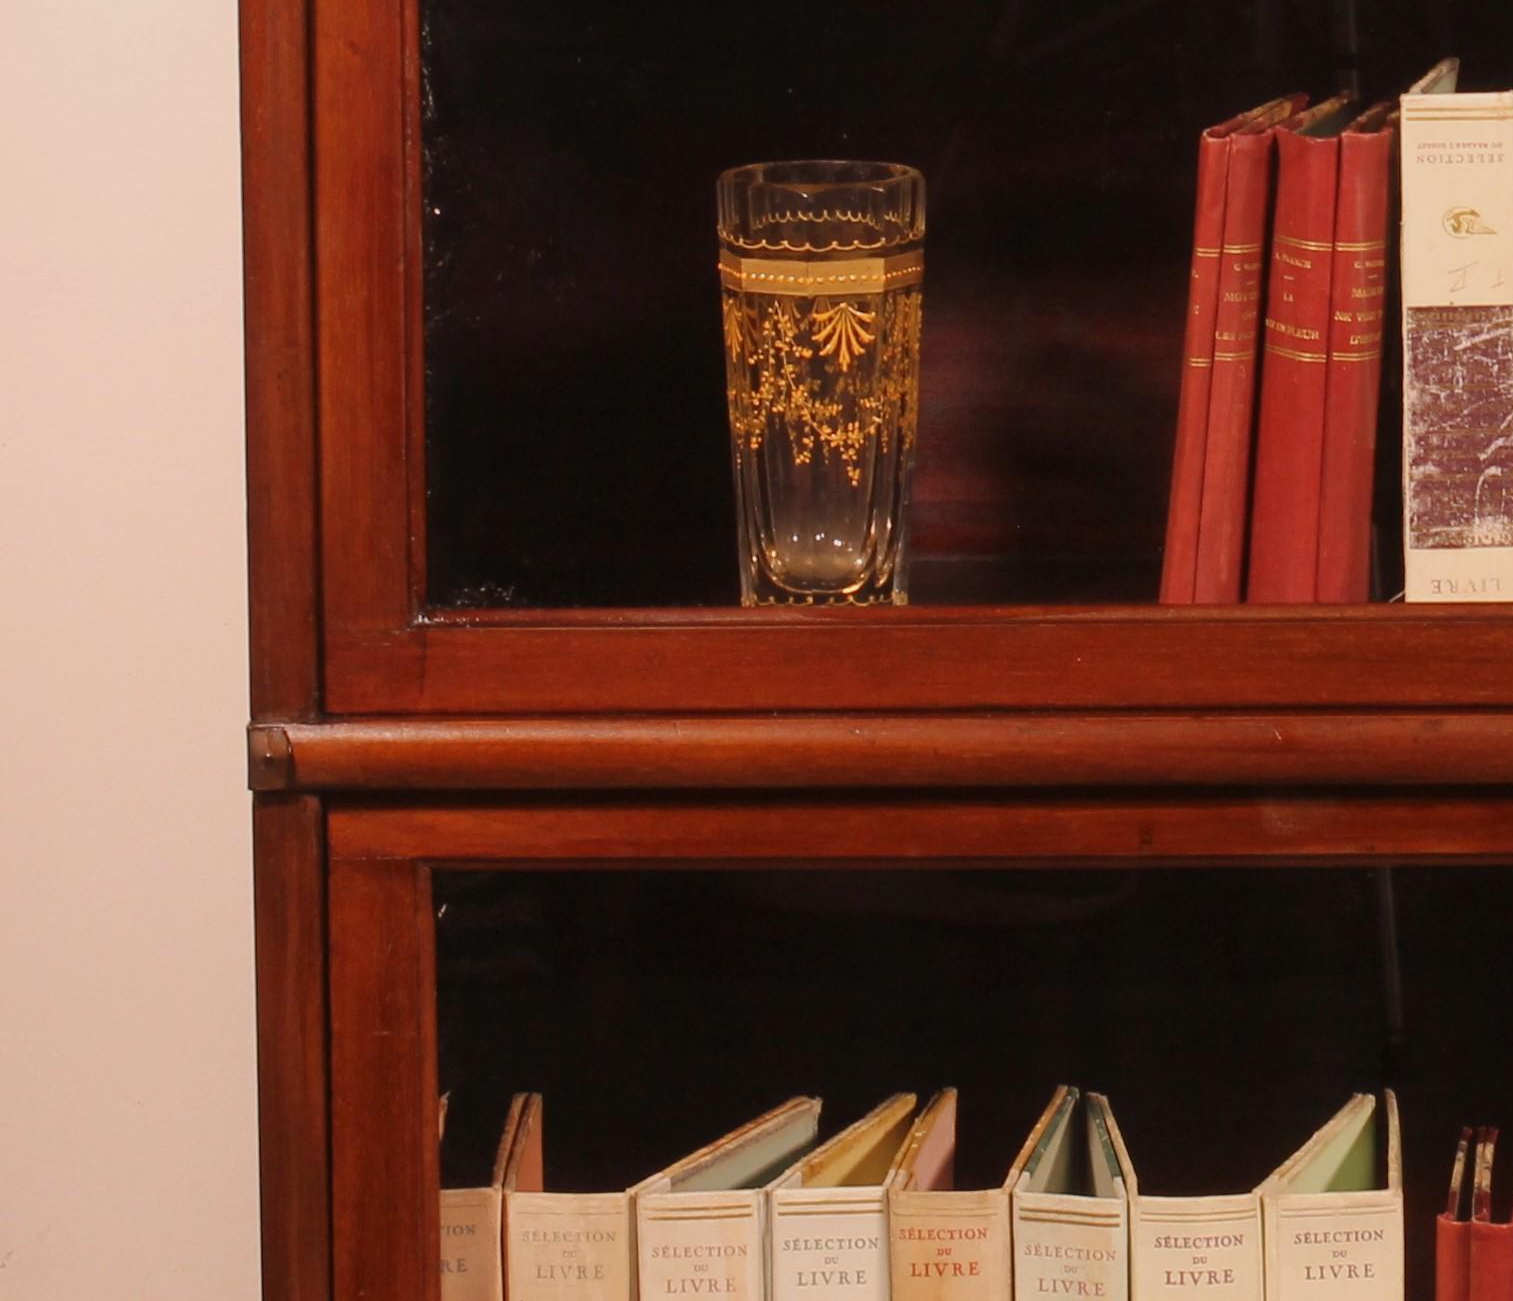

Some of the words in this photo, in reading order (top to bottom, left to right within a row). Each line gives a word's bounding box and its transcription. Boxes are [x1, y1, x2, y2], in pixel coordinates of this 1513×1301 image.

[1432, 578, 1501, 594] LIVRE
[522, 1229, 617, 1243] SÉLECTION
[899, 1226, 988, 1241] SÉLECTION
[1294, 1229, 1385, 1244] SÉLECTION
[782, 1236, 880, 1252] SÉLECTION
[1154, 1234, 1244, 1250] SÉLECTION
[562, 1250, 576, 1259] DU
[651, 1244, 748, 1259] SÉLECTION
[937, 1248, 952, 1256] DU
[1024, 1244, 1116, 1261] SÉLECTION
[1333, 1250, 1348, 1259] DU
[694, 1263, 709, 1273] DU
[824, 1256, 839, 1265] DU
[1192, 1256, 1208, 1265] DU
[536, 1265, 605, 1280] LIVRE
[911, 1262, 980, 1277] LIVRE
[1064, 1265, 1078, 1274] DU
[1305, 1263, 1376, 1280] LIVRE
[796, 1270, 867, 1287] LIVRE
[1164, 1269, 1235, 1286] LIVRE
[666, 1278, 736, 1294] LIVRE
[1038, 1277, 1105, 1297] LIVRE
